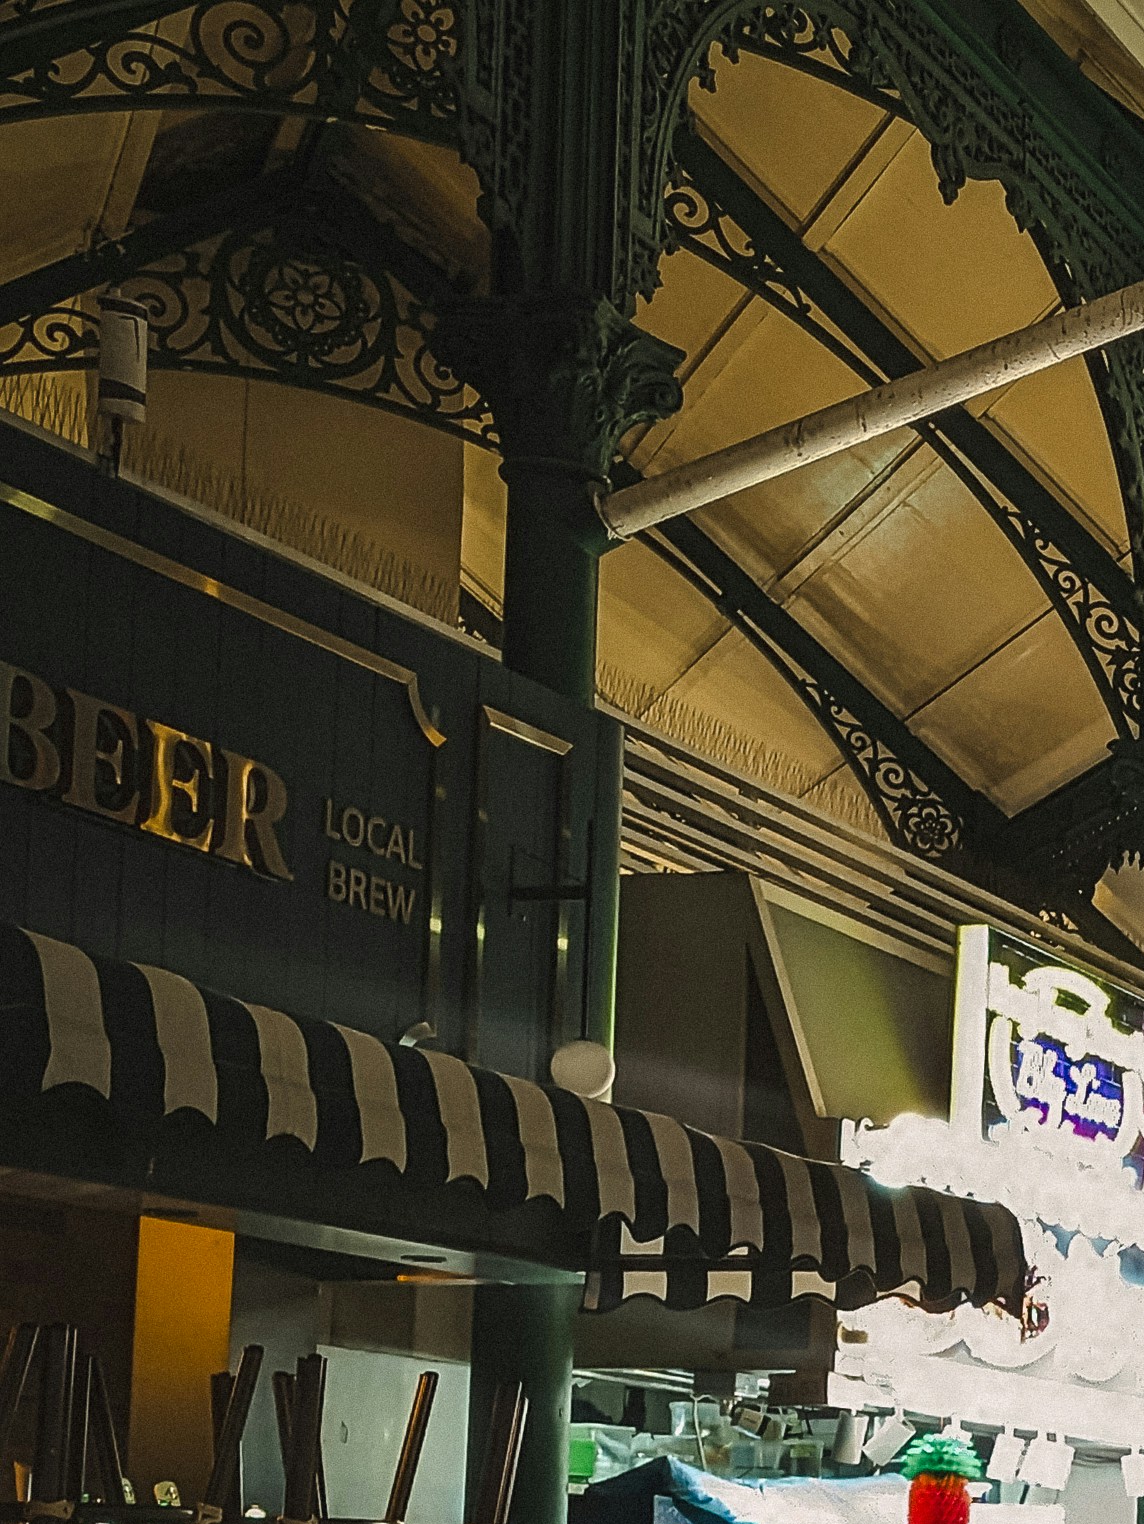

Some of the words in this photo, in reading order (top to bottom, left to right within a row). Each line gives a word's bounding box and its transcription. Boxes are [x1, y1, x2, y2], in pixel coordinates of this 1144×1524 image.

[0, 659, 294, 881] BEER
[326, 798, 423, 870] LOCAL
[328, 860, 416, 925] BREW
